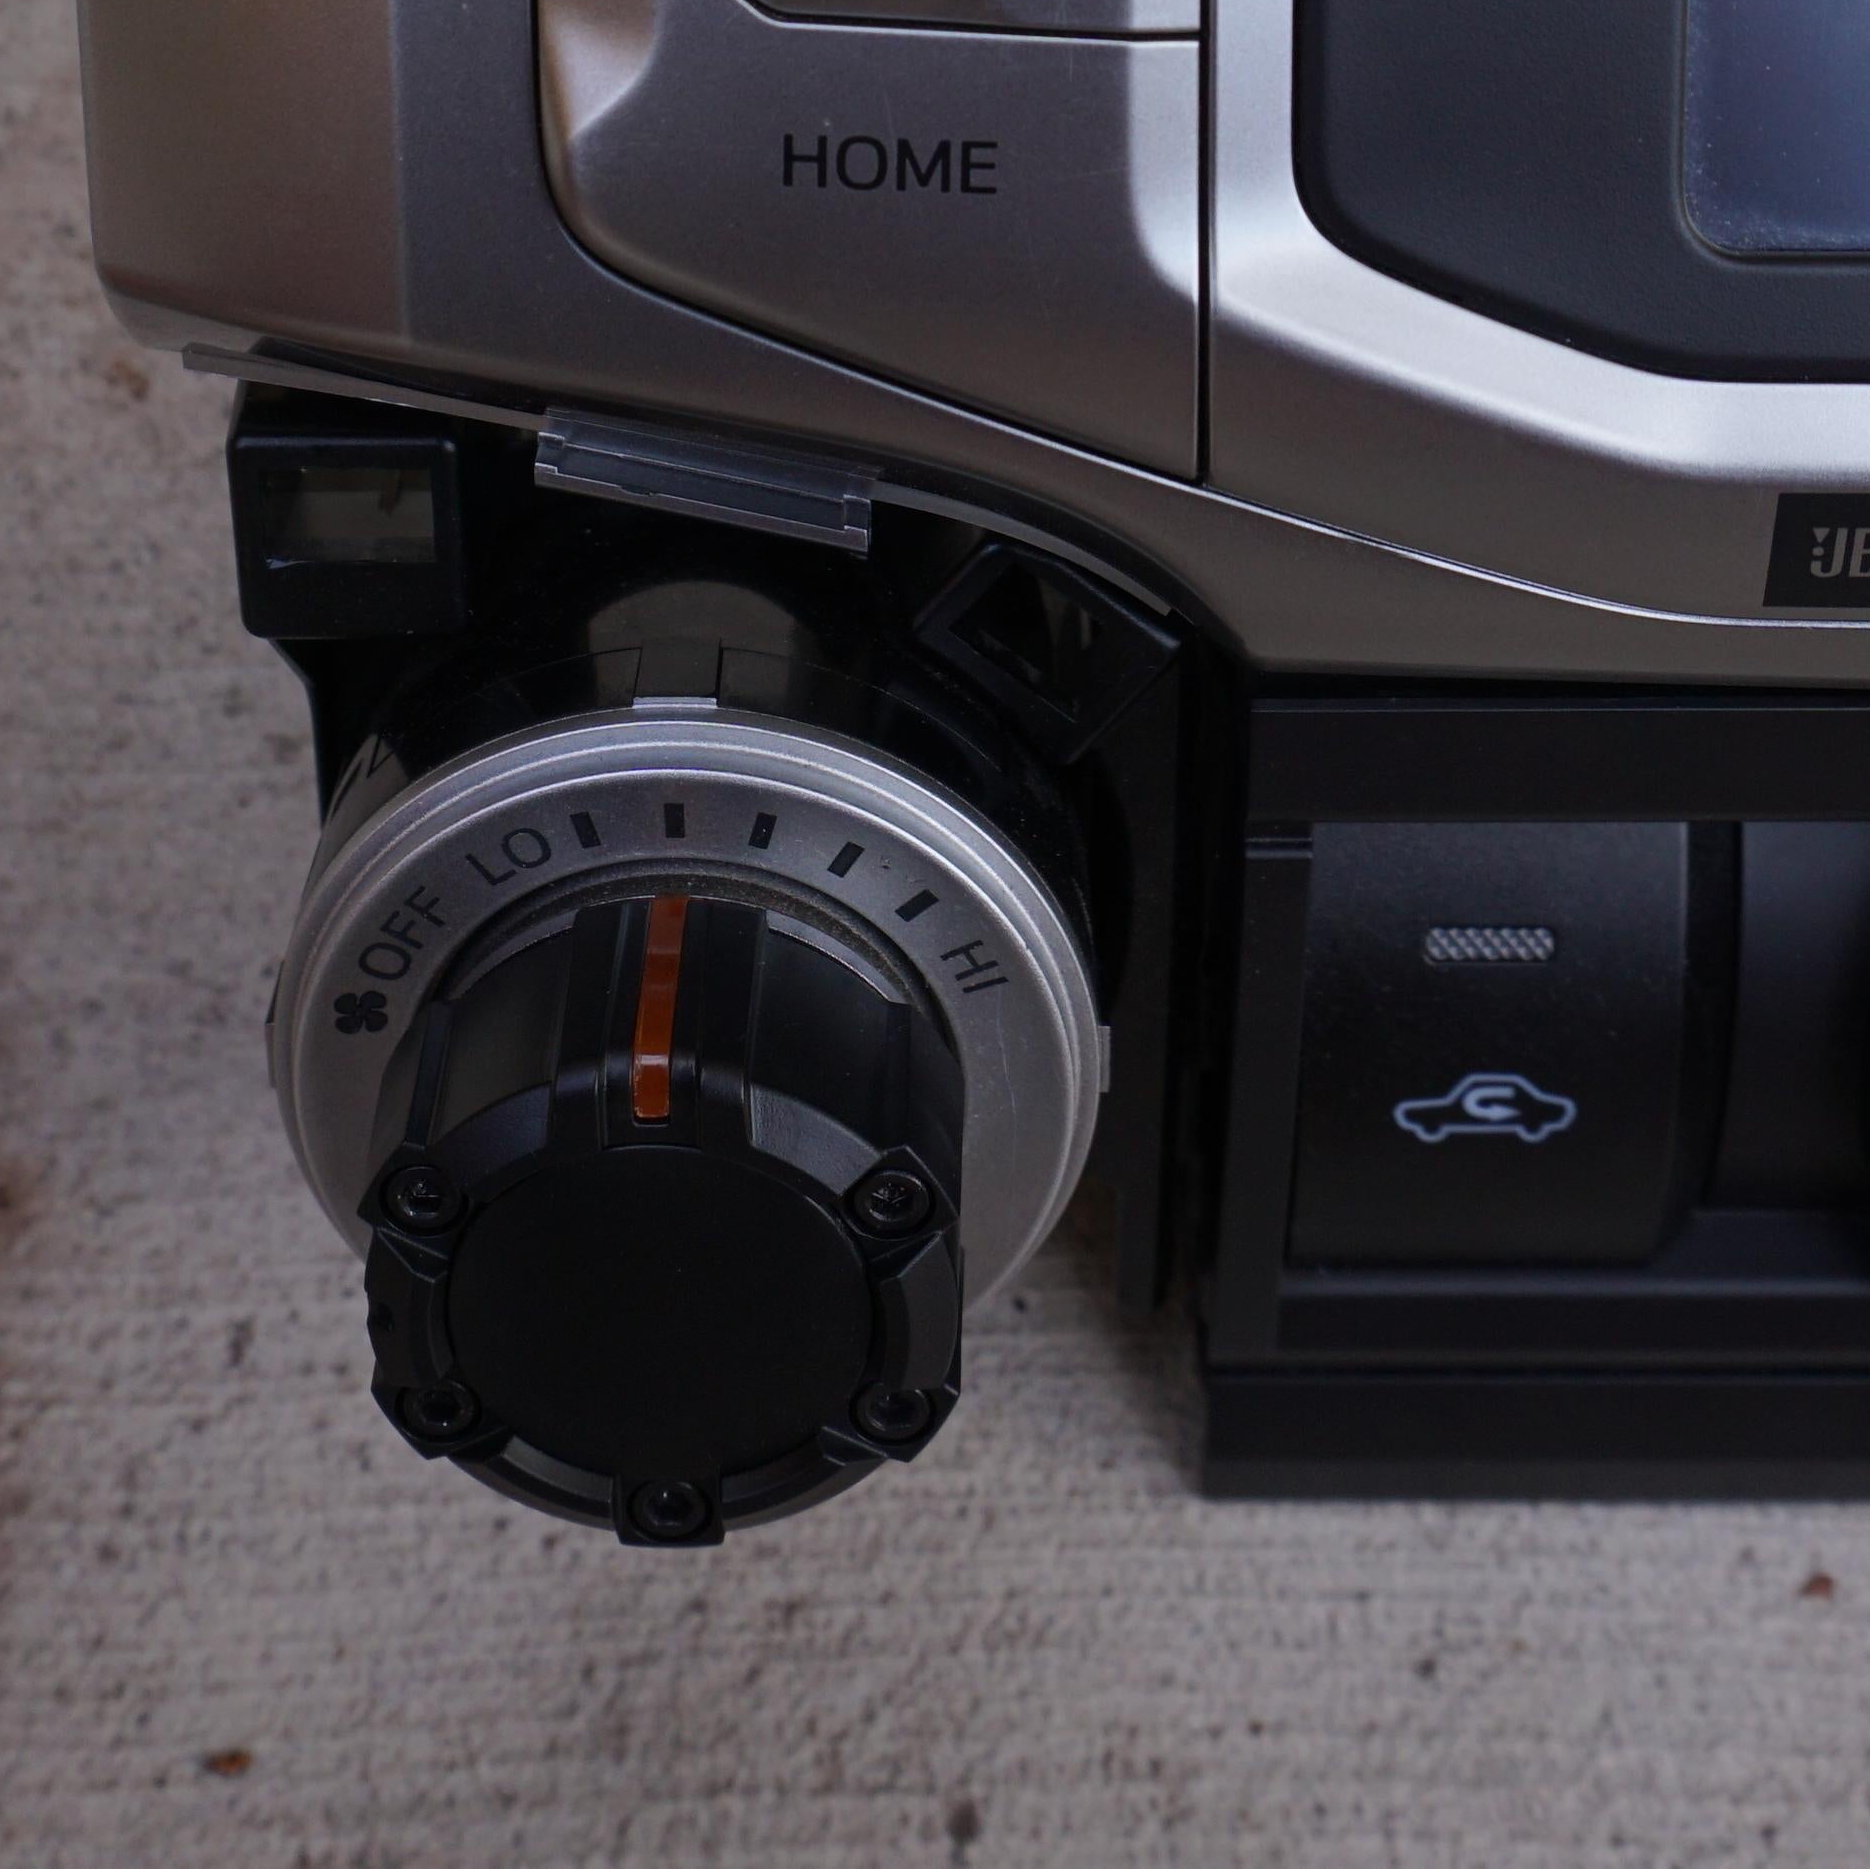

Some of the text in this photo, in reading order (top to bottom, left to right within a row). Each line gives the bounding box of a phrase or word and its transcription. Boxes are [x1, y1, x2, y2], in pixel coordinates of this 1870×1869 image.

[782, 133, 998, 195] HOME
[465, 828, 552, 886] LO
[358, 885, 446, 981] OFF
[940, 939, 1009, 994] HI
